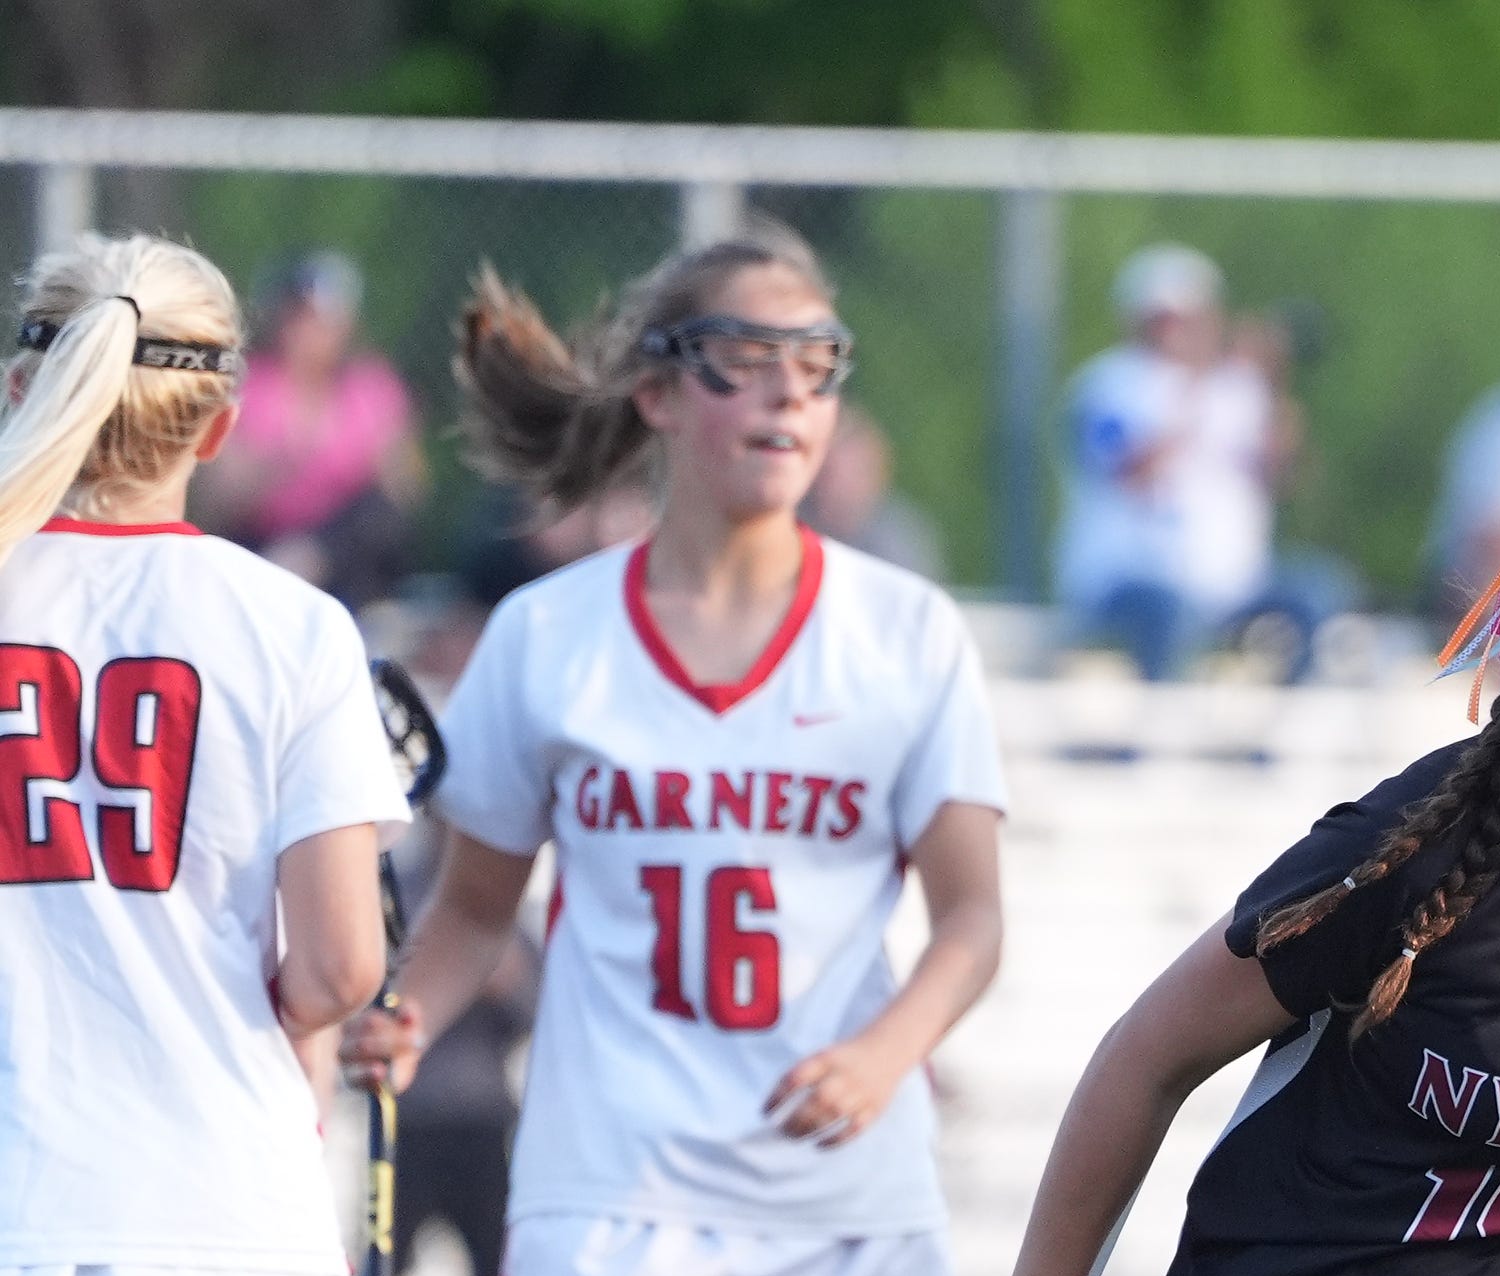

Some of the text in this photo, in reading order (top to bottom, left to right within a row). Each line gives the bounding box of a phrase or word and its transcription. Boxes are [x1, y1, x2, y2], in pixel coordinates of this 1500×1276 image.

[0, 642, 202, 892] 29
[576, 765, 869, 841] GARNETS
[639, 864, 781, 1032] 16
